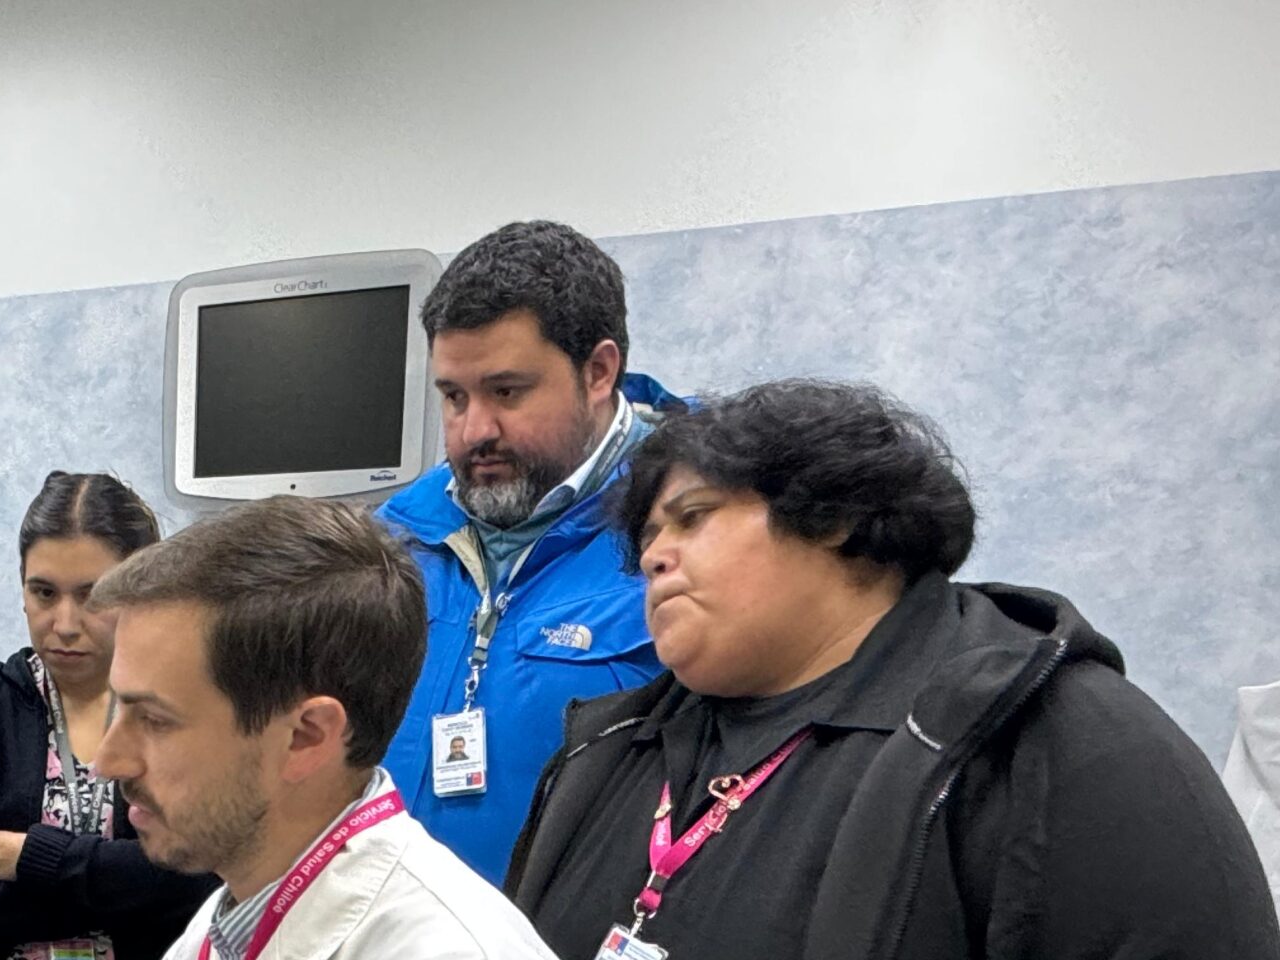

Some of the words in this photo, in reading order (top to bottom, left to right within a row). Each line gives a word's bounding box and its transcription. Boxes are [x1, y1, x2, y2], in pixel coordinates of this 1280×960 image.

[349, 798, 396, 827] Servicio
[332, 826, 349, 841] de
[300, 841, 335, 876] Salud
